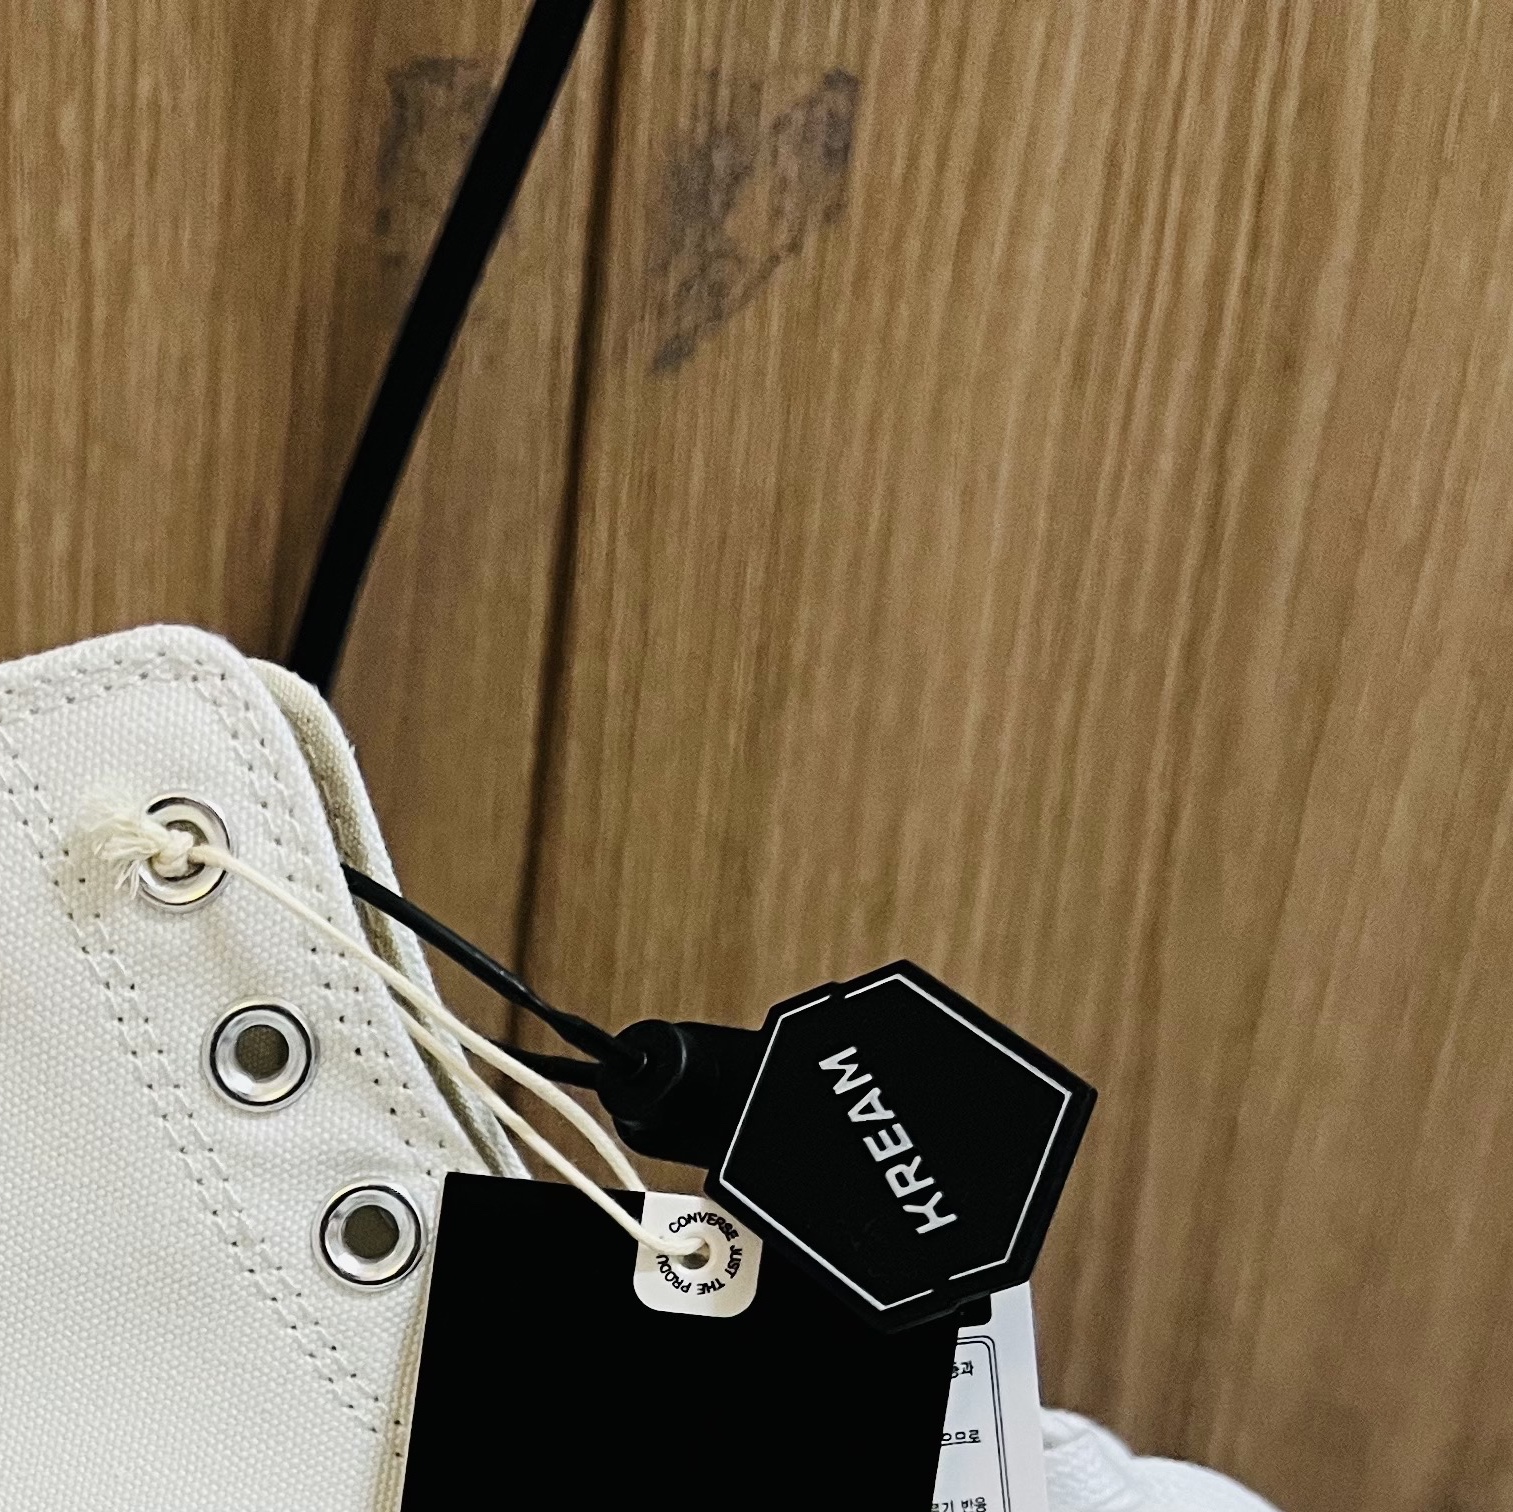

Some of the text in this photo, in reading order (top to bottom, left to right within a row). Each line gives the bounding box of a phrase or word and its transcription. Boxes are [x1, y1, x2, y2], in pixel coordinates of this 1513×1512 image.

[818, 1046, 957, 1236] KREAM
[669, 1212, 739, 1241] CONVERSE
[697, 1278, 726, 1295] THE
